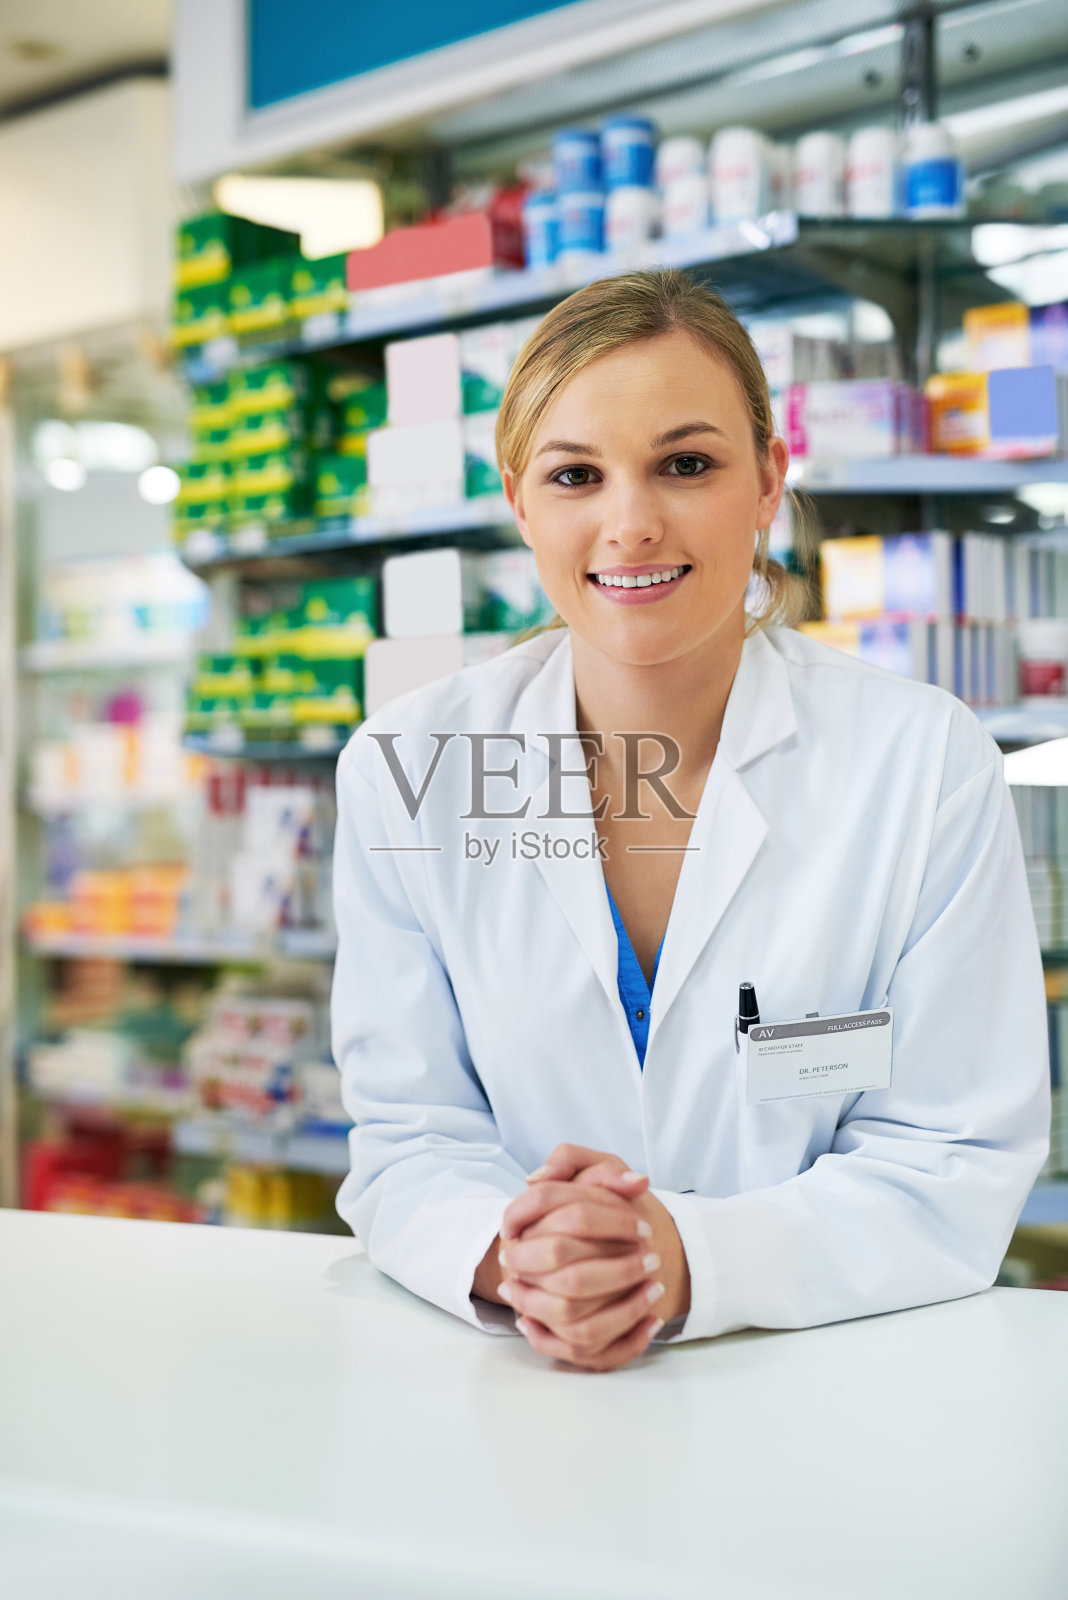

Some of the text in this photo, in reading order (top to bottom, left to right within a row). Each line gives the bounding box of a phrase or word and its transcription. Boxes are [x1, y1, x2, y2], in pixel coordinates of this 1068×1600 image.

[827, 1018, 883, 1032] FULL ACCESS PASS
[758, 1028, 775, 1039] AV
[799, 1062, 849, 1075] DR. PETERSON
